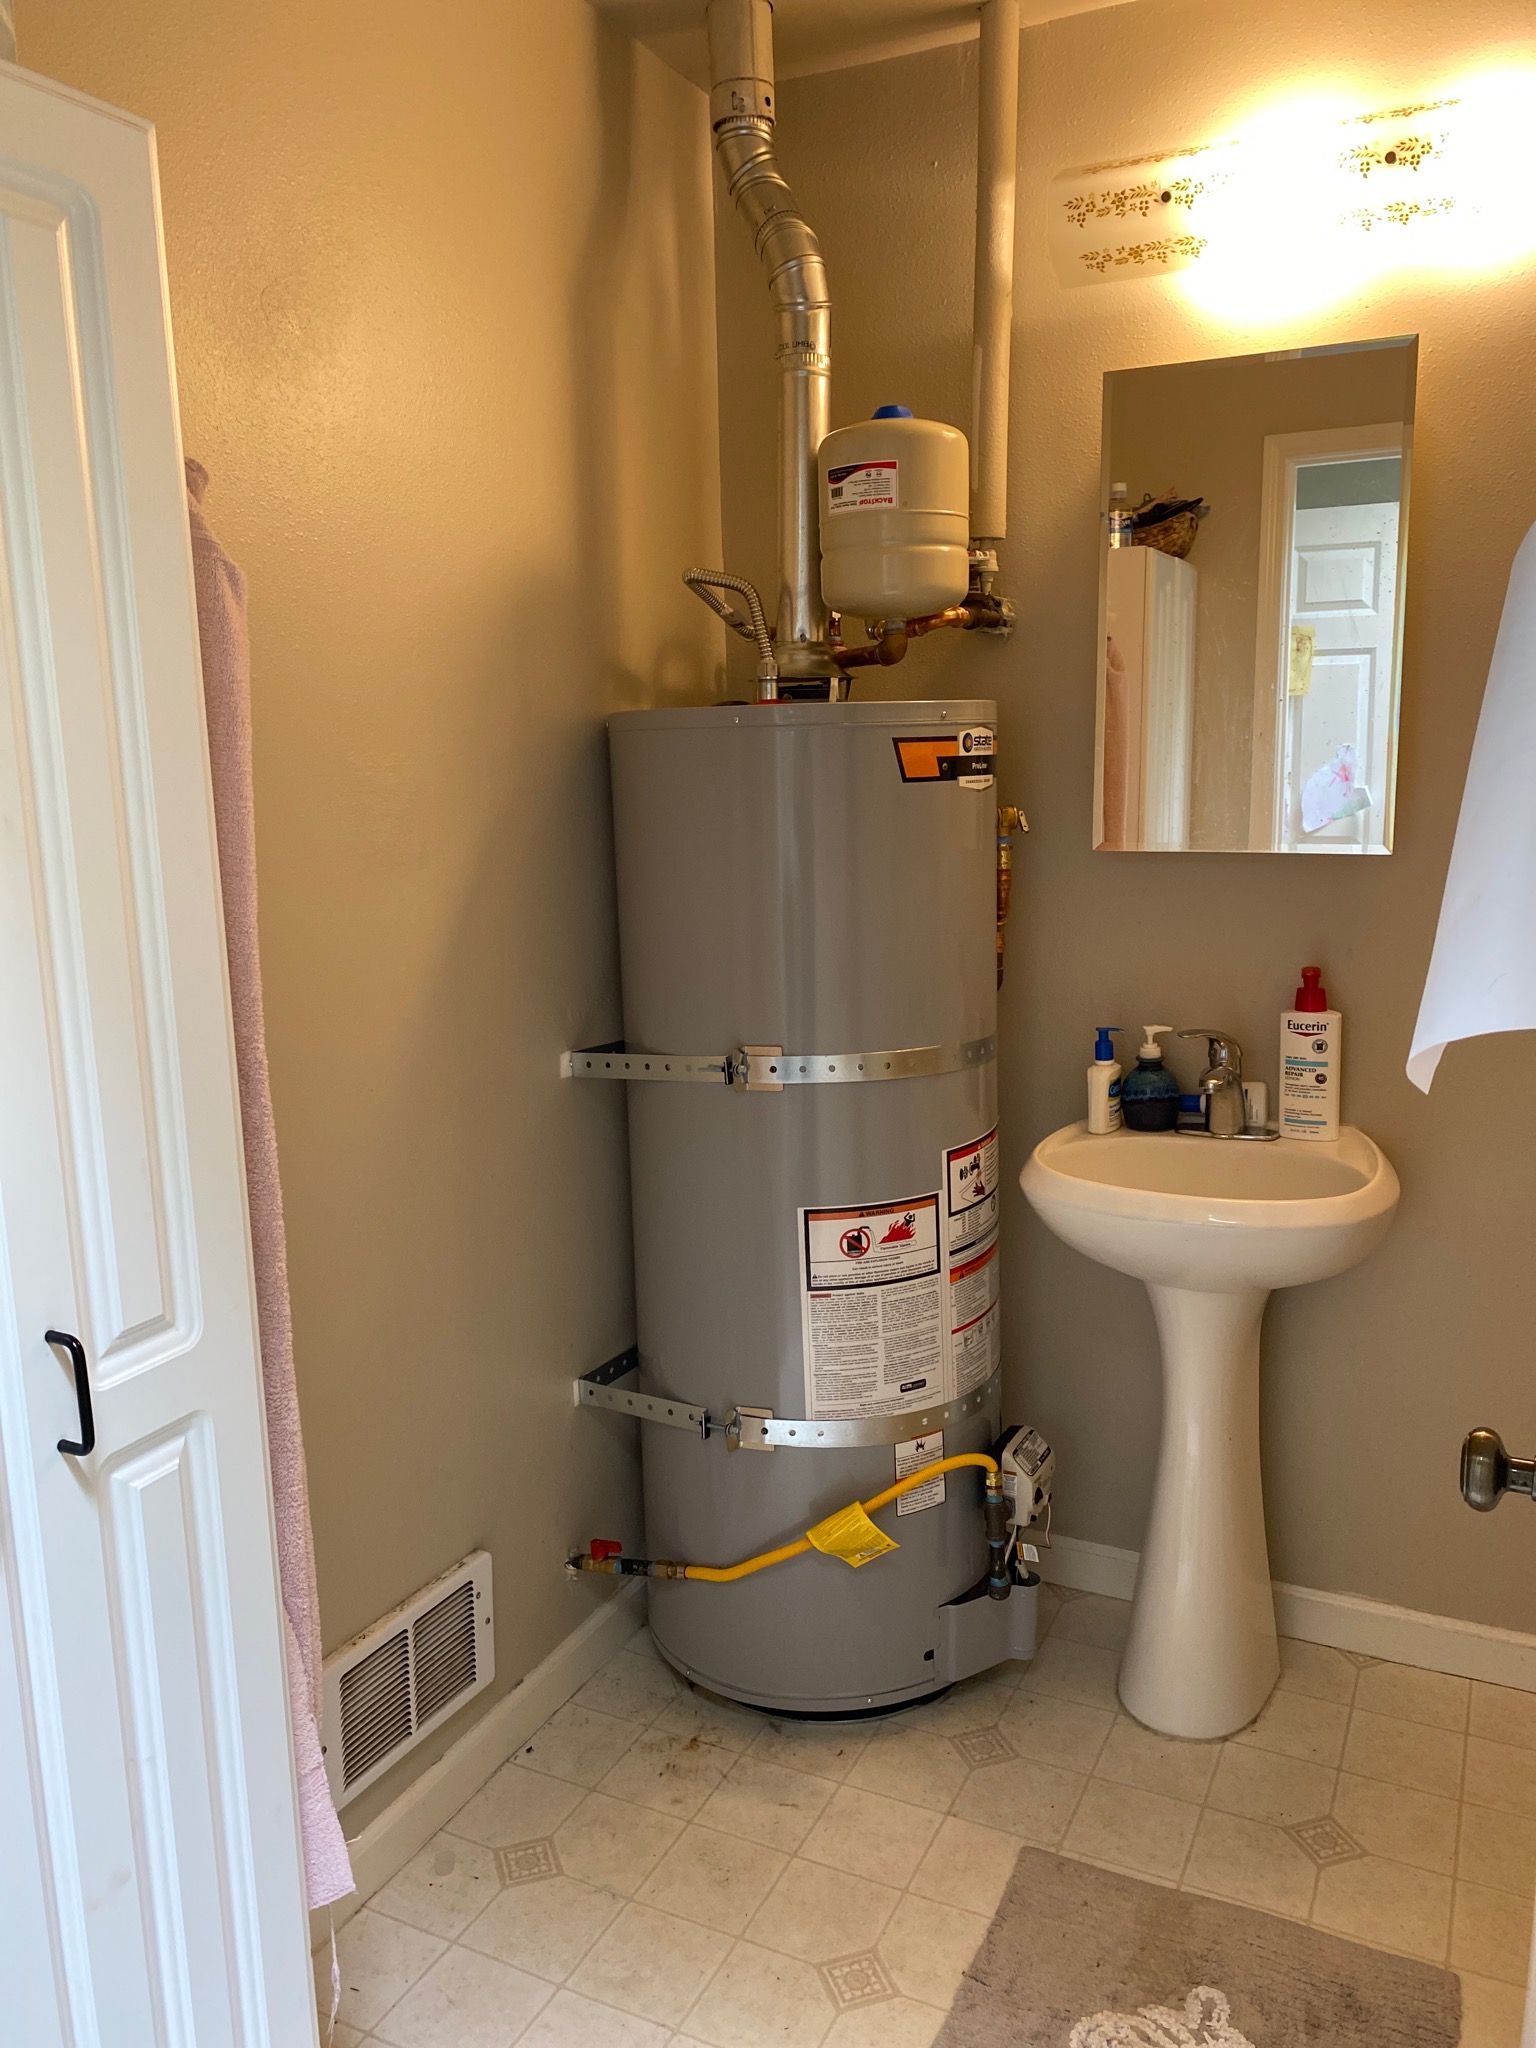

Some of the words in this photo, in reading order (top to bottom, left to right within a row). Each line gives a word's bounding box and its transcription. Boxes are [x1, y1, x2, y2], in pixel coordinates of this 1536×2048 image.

[974, 735, 992, 746] state
[1287, 1019, 1327, 1032] Eucerin
[866, 1208, 895, 1217] WARNING
